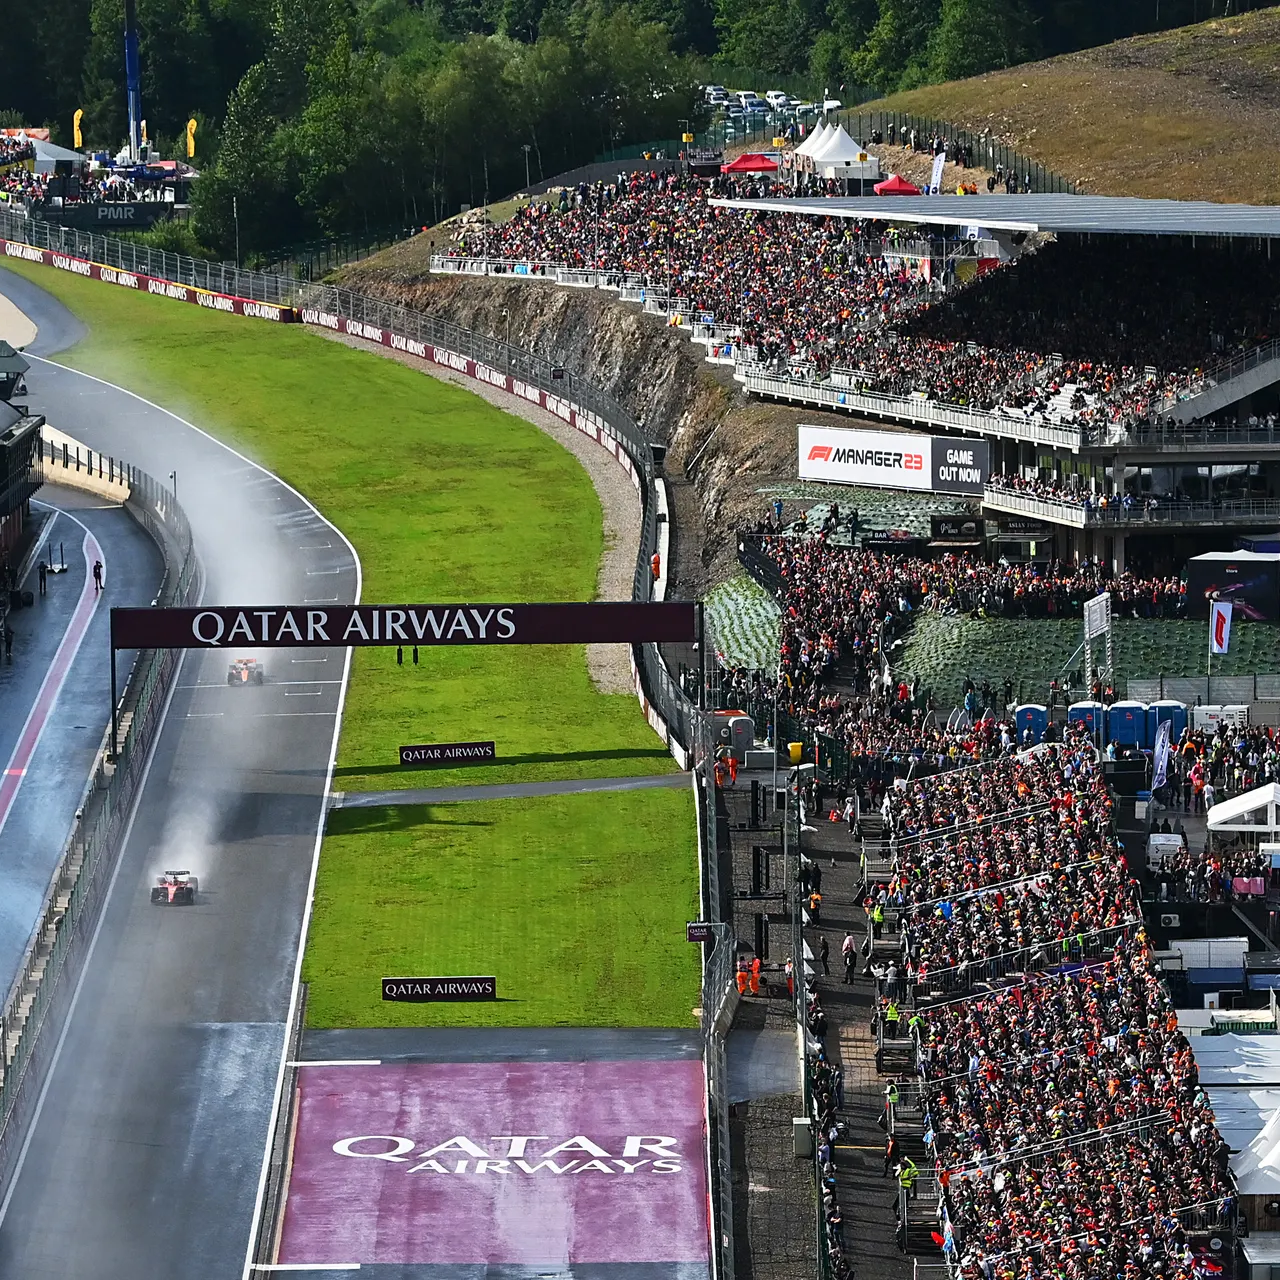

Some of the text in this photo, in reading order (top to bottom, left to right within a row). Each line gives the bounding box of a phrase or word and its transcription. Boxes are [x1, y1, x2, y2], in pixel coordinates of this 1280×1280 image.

[97, 206, 135, 220] PMR
[5, 242, 22, 257] QATAR
[52, 254, 91, 276] QATAR AIRWAYS
[100, 267, 139, 289] QATAR AIRWAYS
[148, 279, 187, 301] QATAR AIRWAYS
[196, 292, 213, 307] QATAR
[243, 303, 260, 317] QATAR
[301, 309, 339, 329] QATAR AIRWAYS
[346, 320, 383, 343] QATAR AIRWAYS
[390, 334, 407, 350] QATAR
[832, 448, 903, 469] MANAGER
[904, 453, 923, 470] 23
[946, 449, 974, 466] GAME
[939, 465, 981, 484] OUT NOW
[192, 608, 516, 645] QATAR AIRWAYS
[402, 746, 492, 761] QATAR AIRWAYS
[385, 982, 492, 997] QATAR AIRWAYS
[332, 1135, 683, 1162] QATAR
[406, 1159, 683, 1174] AIRWAYS
